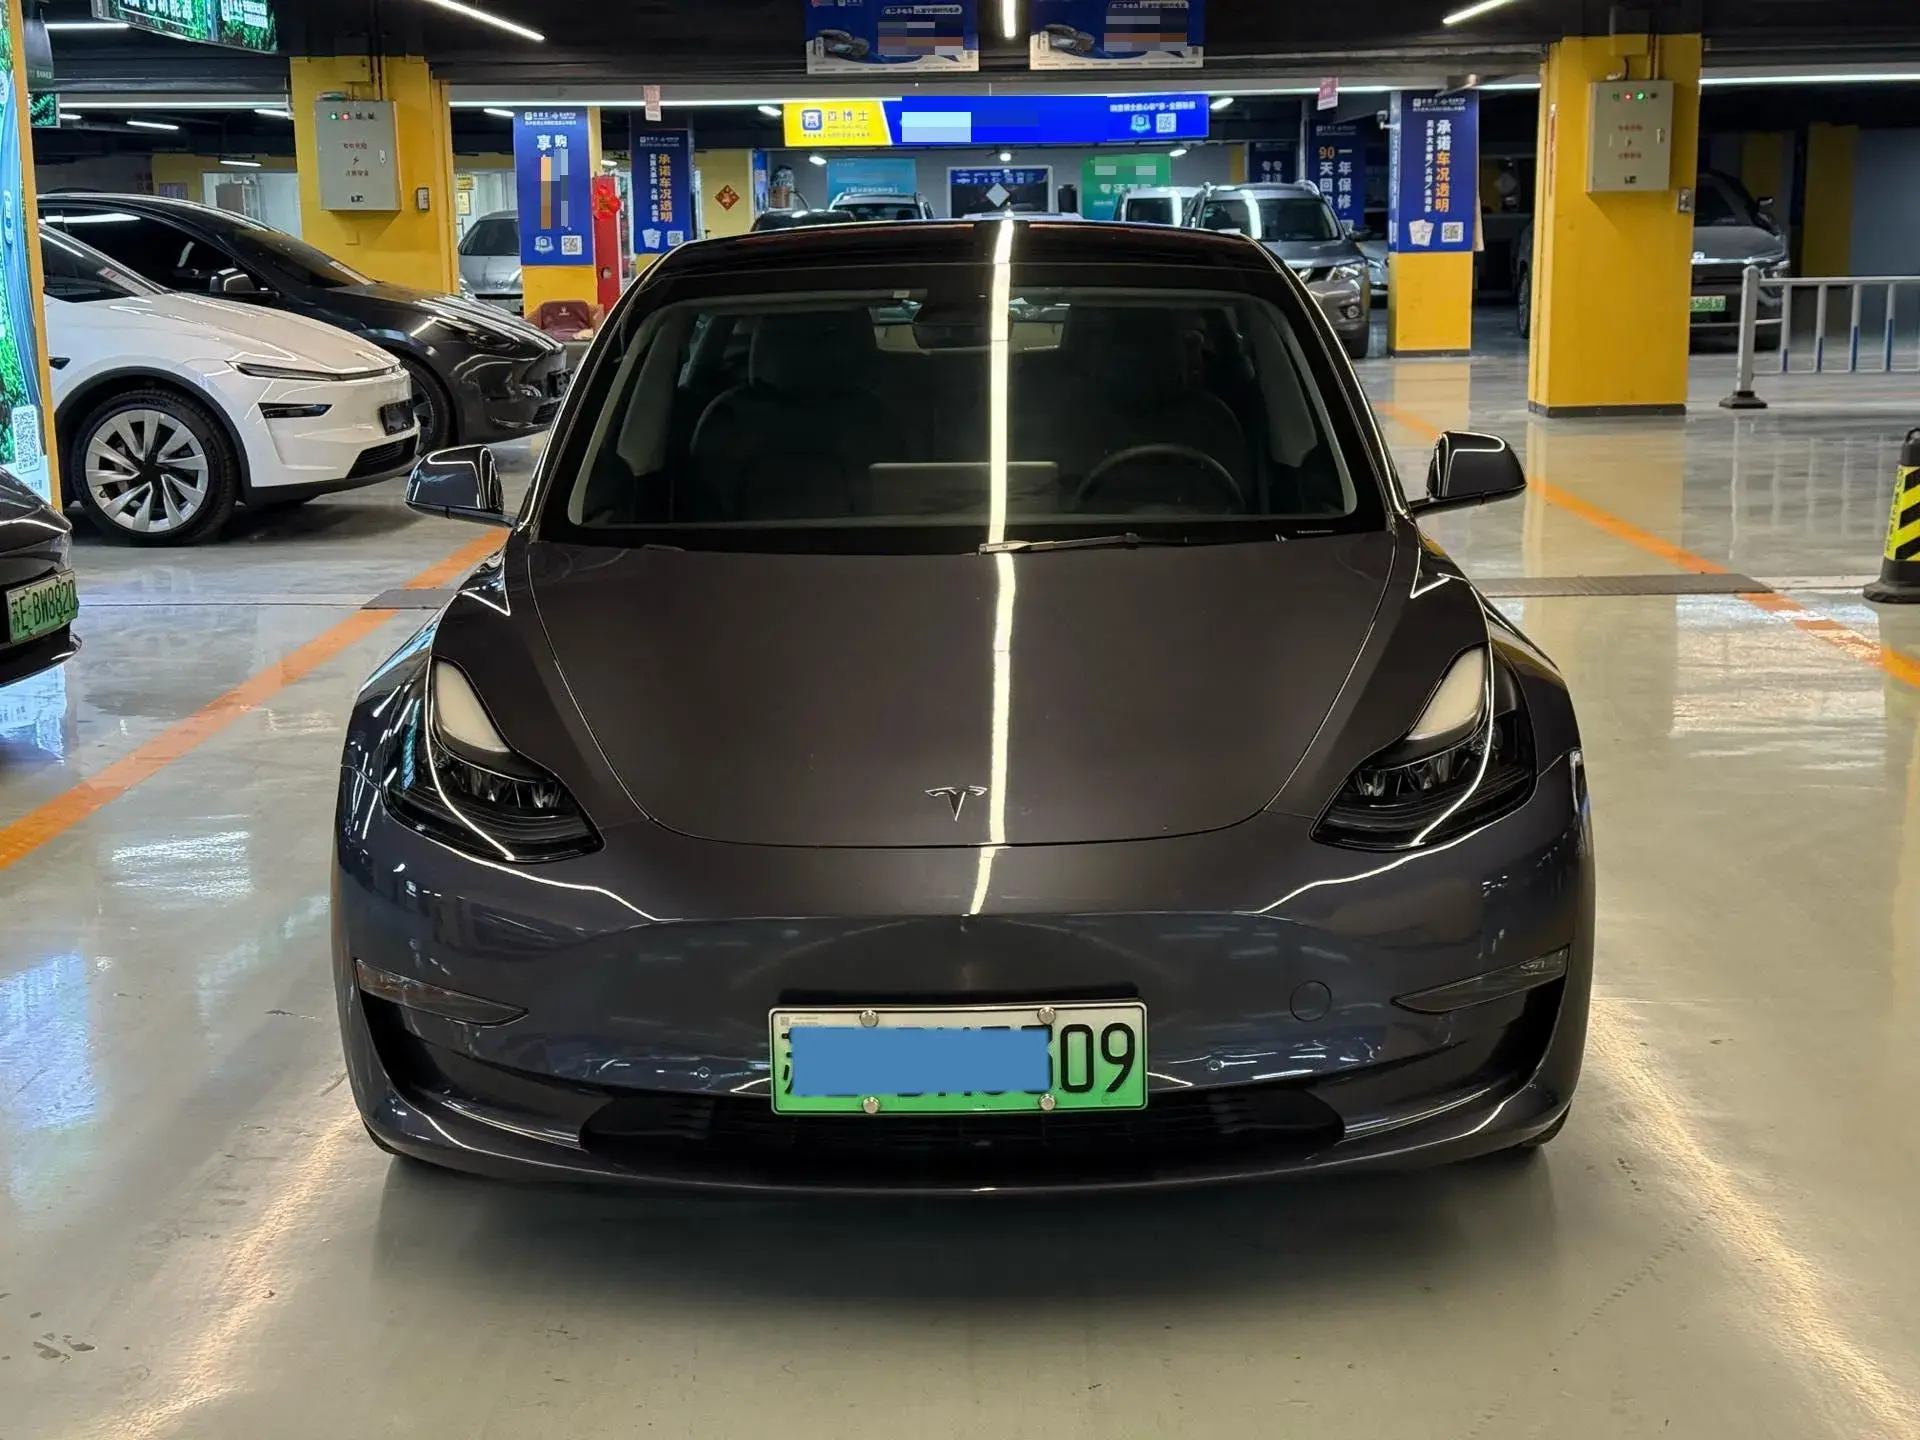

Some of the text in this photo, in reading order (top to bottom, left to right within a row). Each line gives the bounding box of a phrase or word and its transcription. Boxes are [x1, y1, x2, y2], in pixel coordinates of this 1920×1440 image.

[658, 153, 673, 223] 承诺车况透明
[1338, 148, 1353, 210] 一年保修
[1435, 119, 1451, 213] 承诺车况透明
